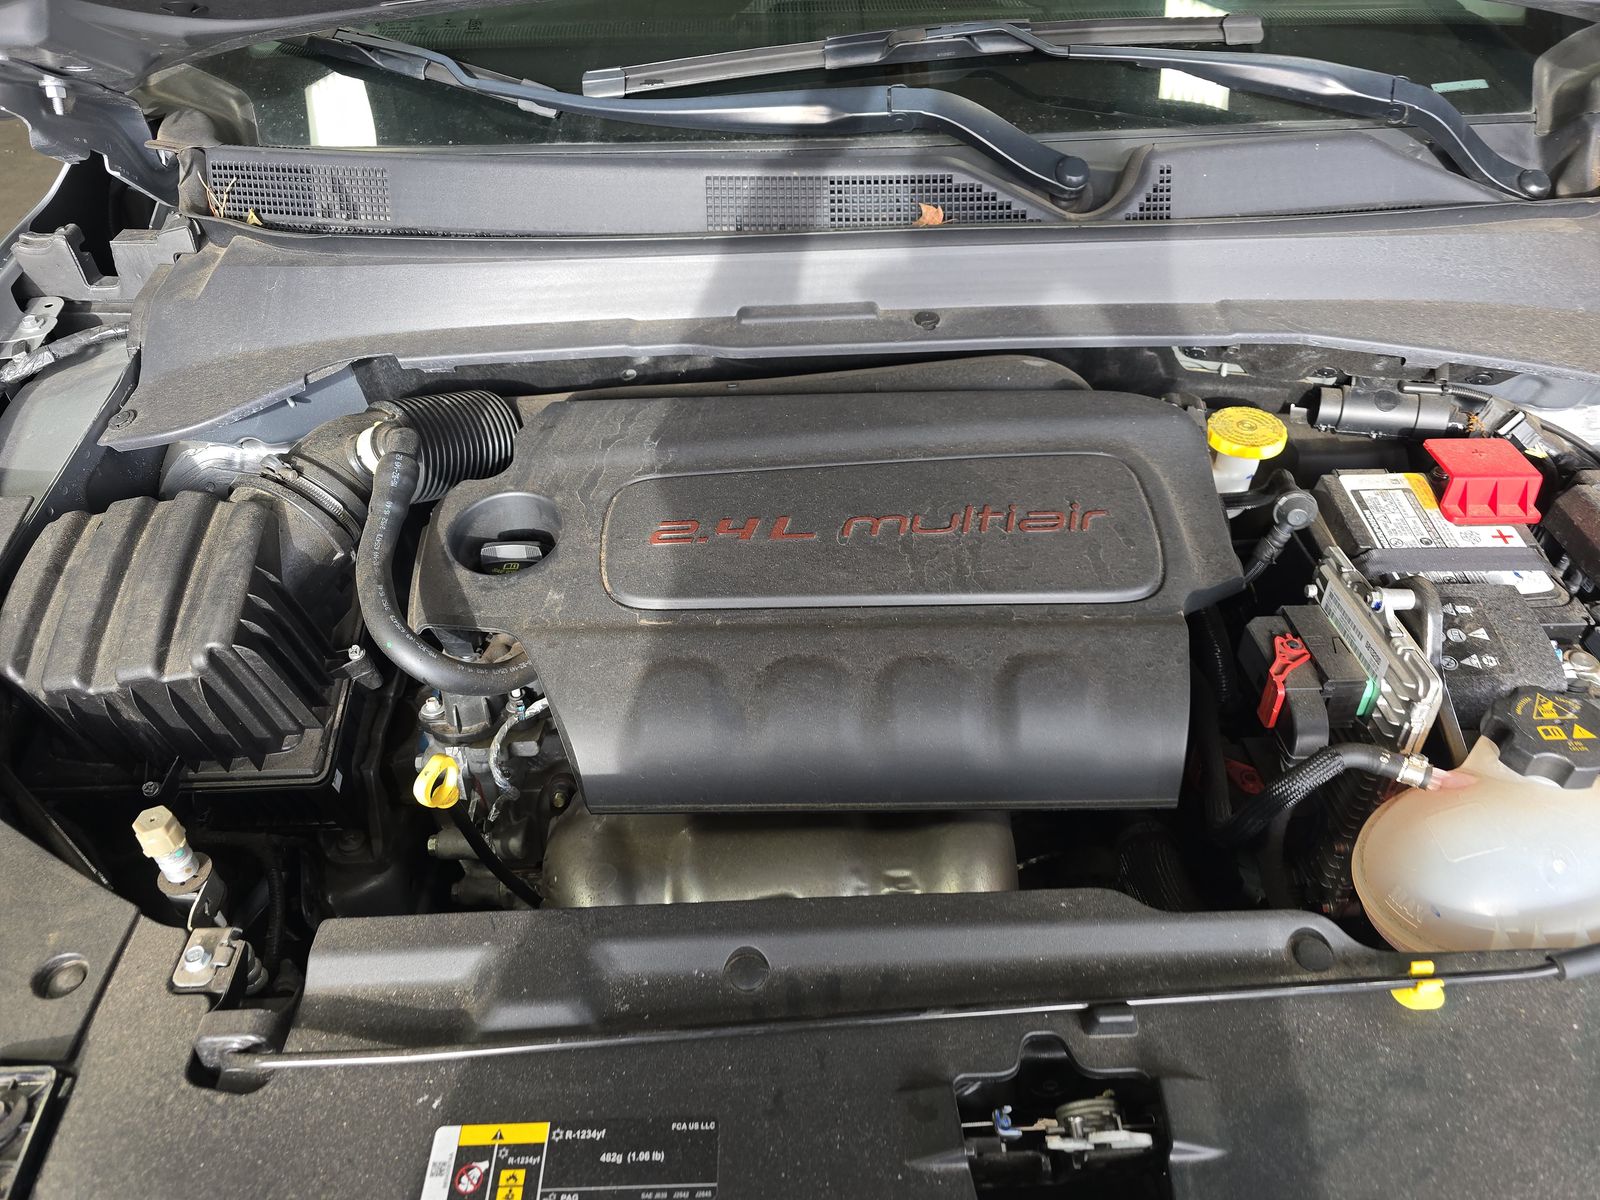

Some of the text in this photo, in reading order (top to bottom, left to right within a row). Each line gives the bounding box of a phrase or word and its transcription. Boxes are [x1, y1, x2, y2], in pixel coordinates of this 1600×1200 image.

[843, 503, 1108, 537] multiair
[671, 1121, 716, 1131] FCA US LLC
[565, 1128, 607, 1141] R-1234yf
[508, 1155, 541, 1166] R-1234yf
[652, 1150, 665, 1162] lb)
